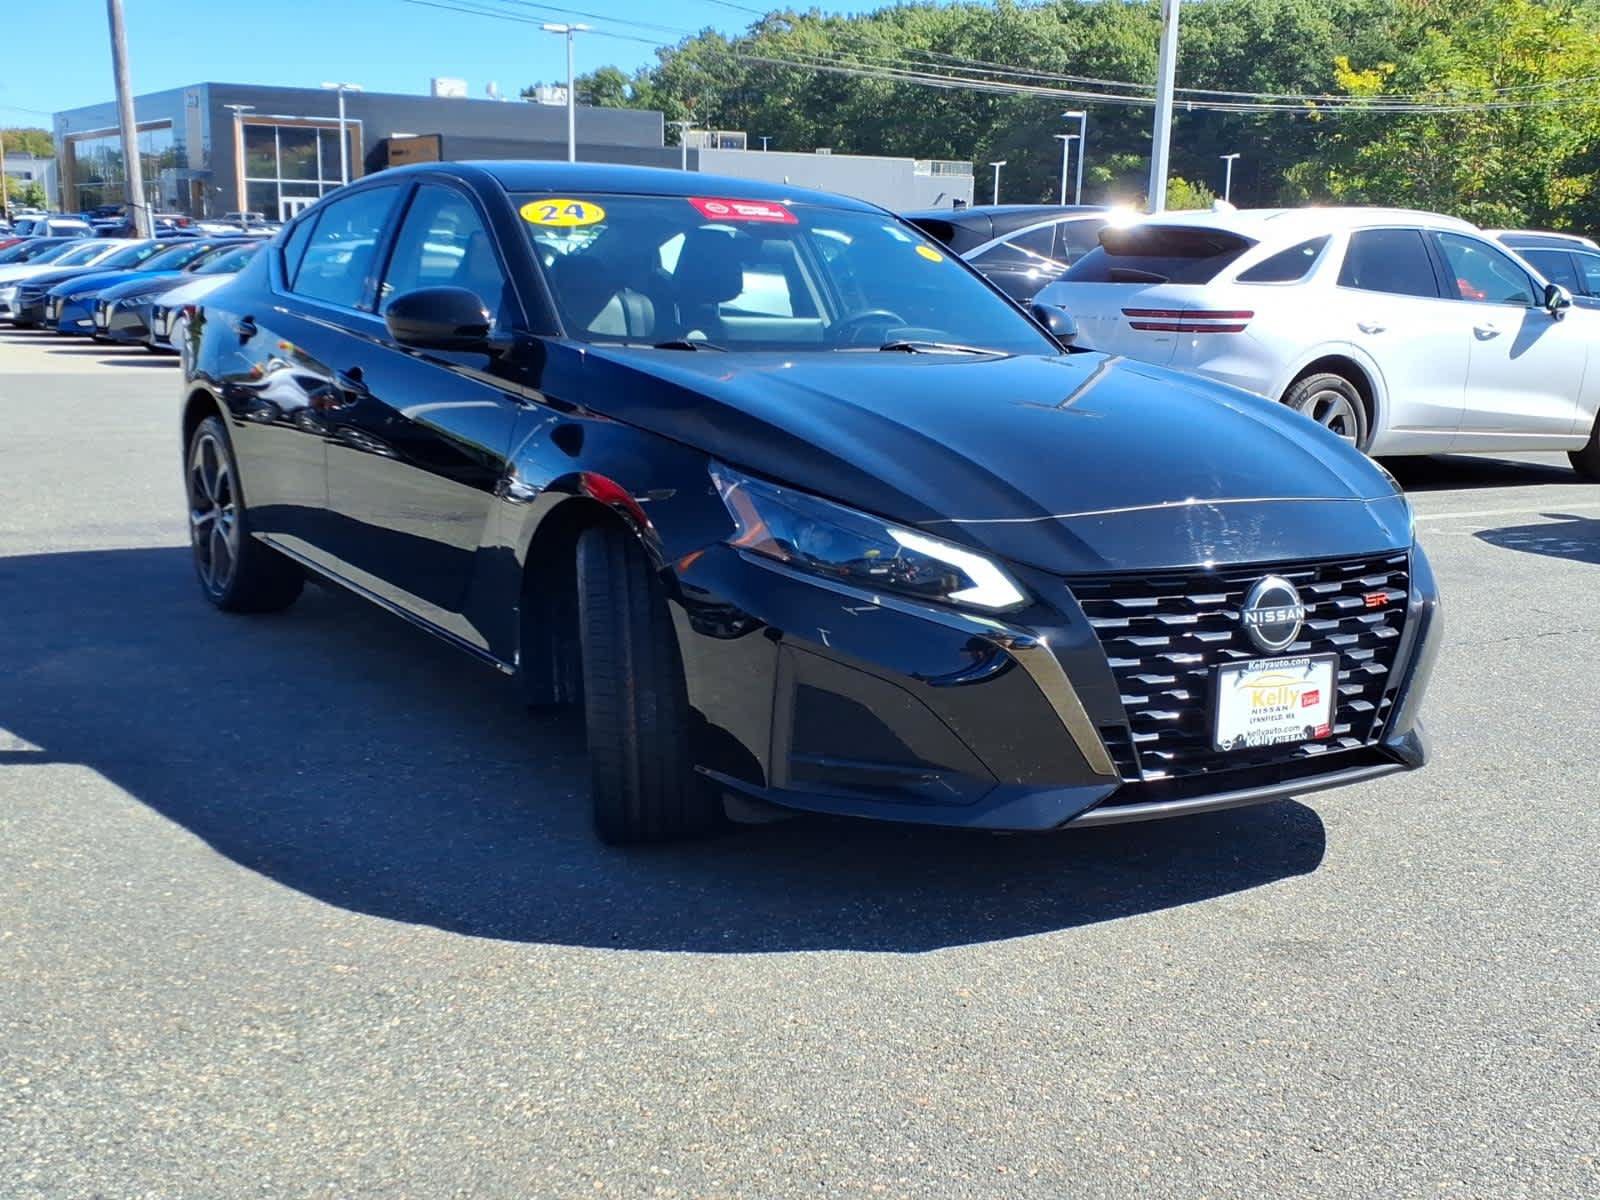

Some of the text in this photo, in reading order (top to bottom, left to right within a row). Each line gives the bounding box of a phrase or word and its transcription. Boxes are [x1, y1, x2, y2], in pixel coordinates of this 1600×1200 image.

[539, 204, 584, 221] 24
[1365, 592, 1388, 608] SR
[1244, 608, 1305, 624] NISSAN
[1248, 658, 1310, 673] Kellyauto.com
[1252, 687, 1299, 709] Kelly
[1251, 704, 1289, 715] NISSAN
[1247, 725, 1300, 738] kellyauto.com
